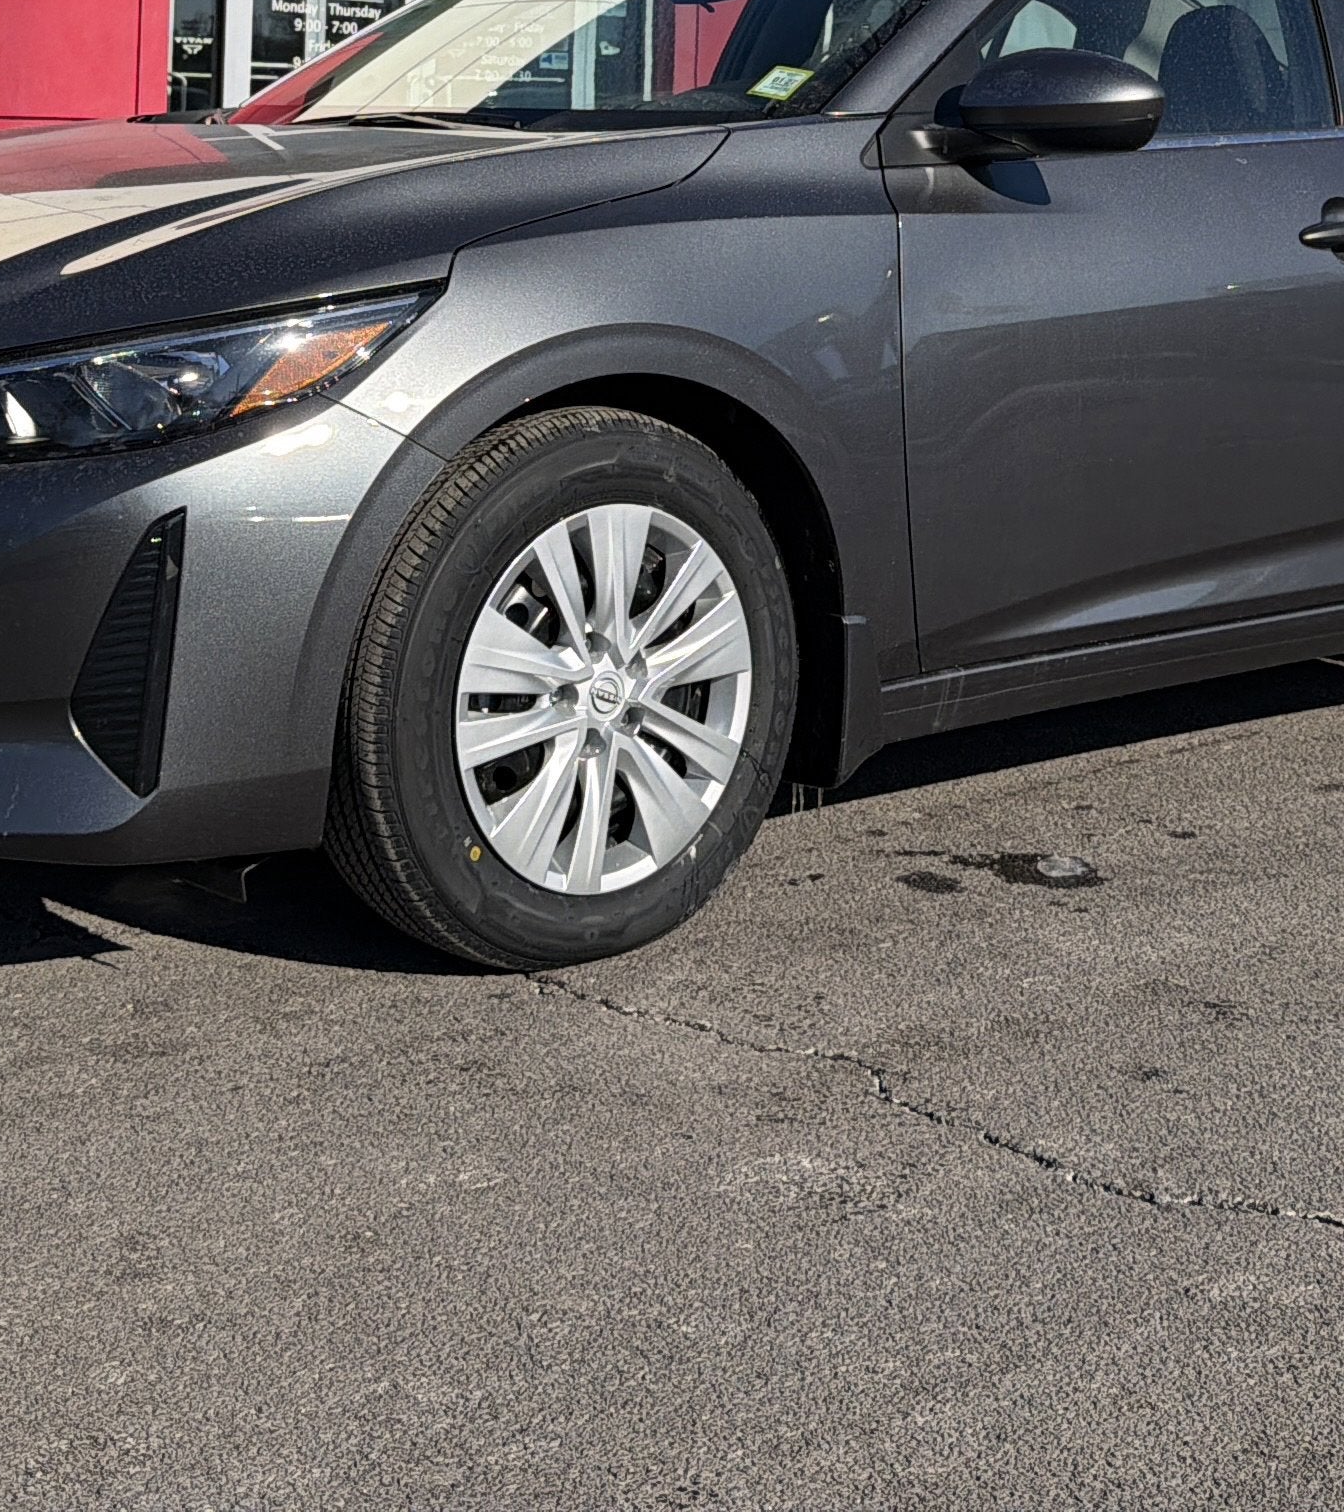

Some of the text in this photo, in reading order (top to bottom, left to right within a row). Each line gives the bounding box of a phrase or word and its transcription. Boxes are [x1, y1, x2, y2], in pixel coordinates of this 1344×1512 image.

[328, 2, 382, 20] Thursday
[294, 19, 321, 33] 9:00
[331, 20, 358, 34] 7:00
